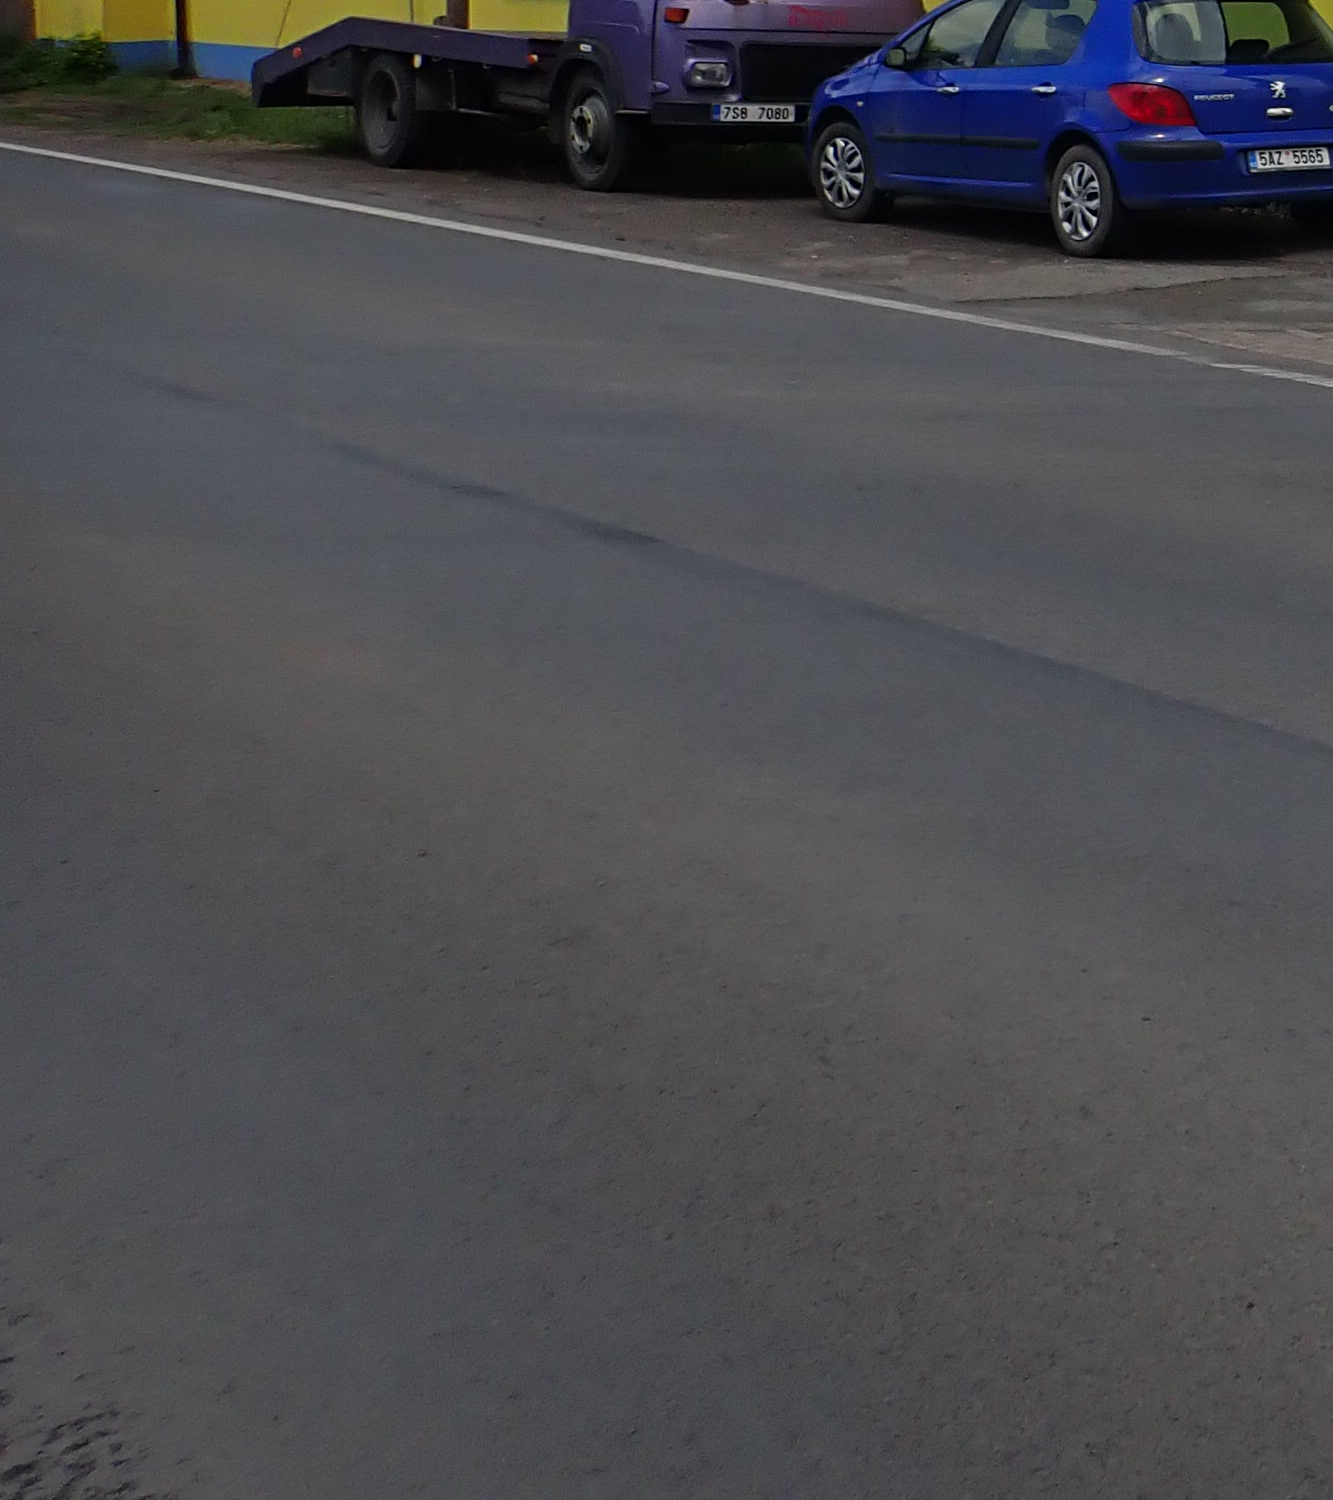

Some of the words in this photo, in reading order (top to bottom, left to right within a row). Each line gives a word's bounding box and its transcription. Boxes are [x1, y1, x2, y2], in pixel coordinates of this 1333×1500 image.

[758, 107, 790, 120] 7080
[1259, 151, 1284, 166] 5AZ
[1292, 149, 1323, 165] 5565
